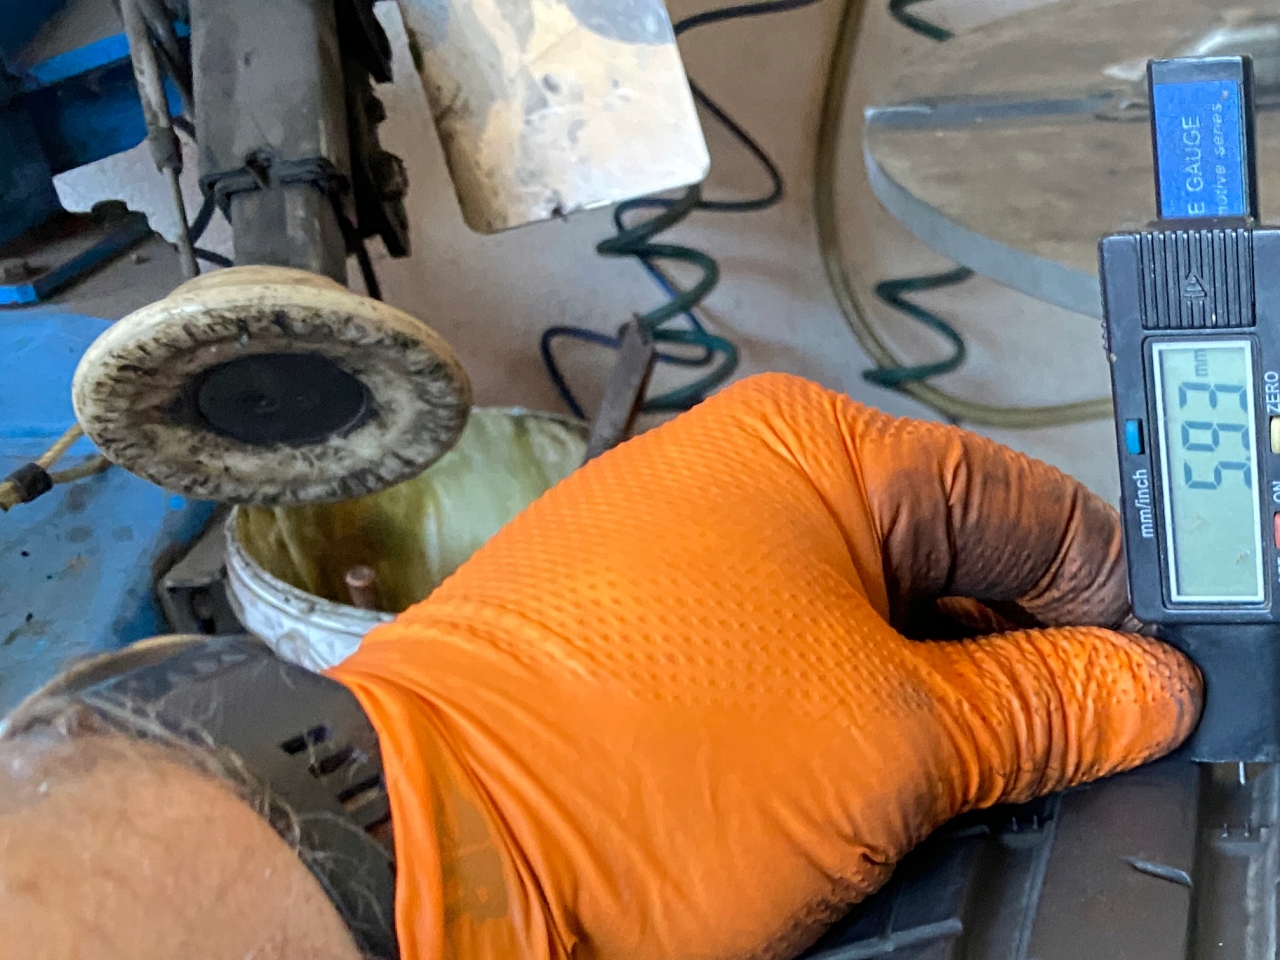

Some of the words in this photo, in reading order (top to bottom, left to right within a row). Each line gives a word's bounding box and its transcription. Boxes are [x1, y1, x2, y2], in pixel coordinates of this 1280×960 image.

[1182, 115, 1204, 192] GAUGE
[1212, 102, 1225, 158] series
[1193, 350, 1207, 377] mm
[1264, 371, 1279, 414] ZERO
[1132, 469, 1154, 538] mm/inch
